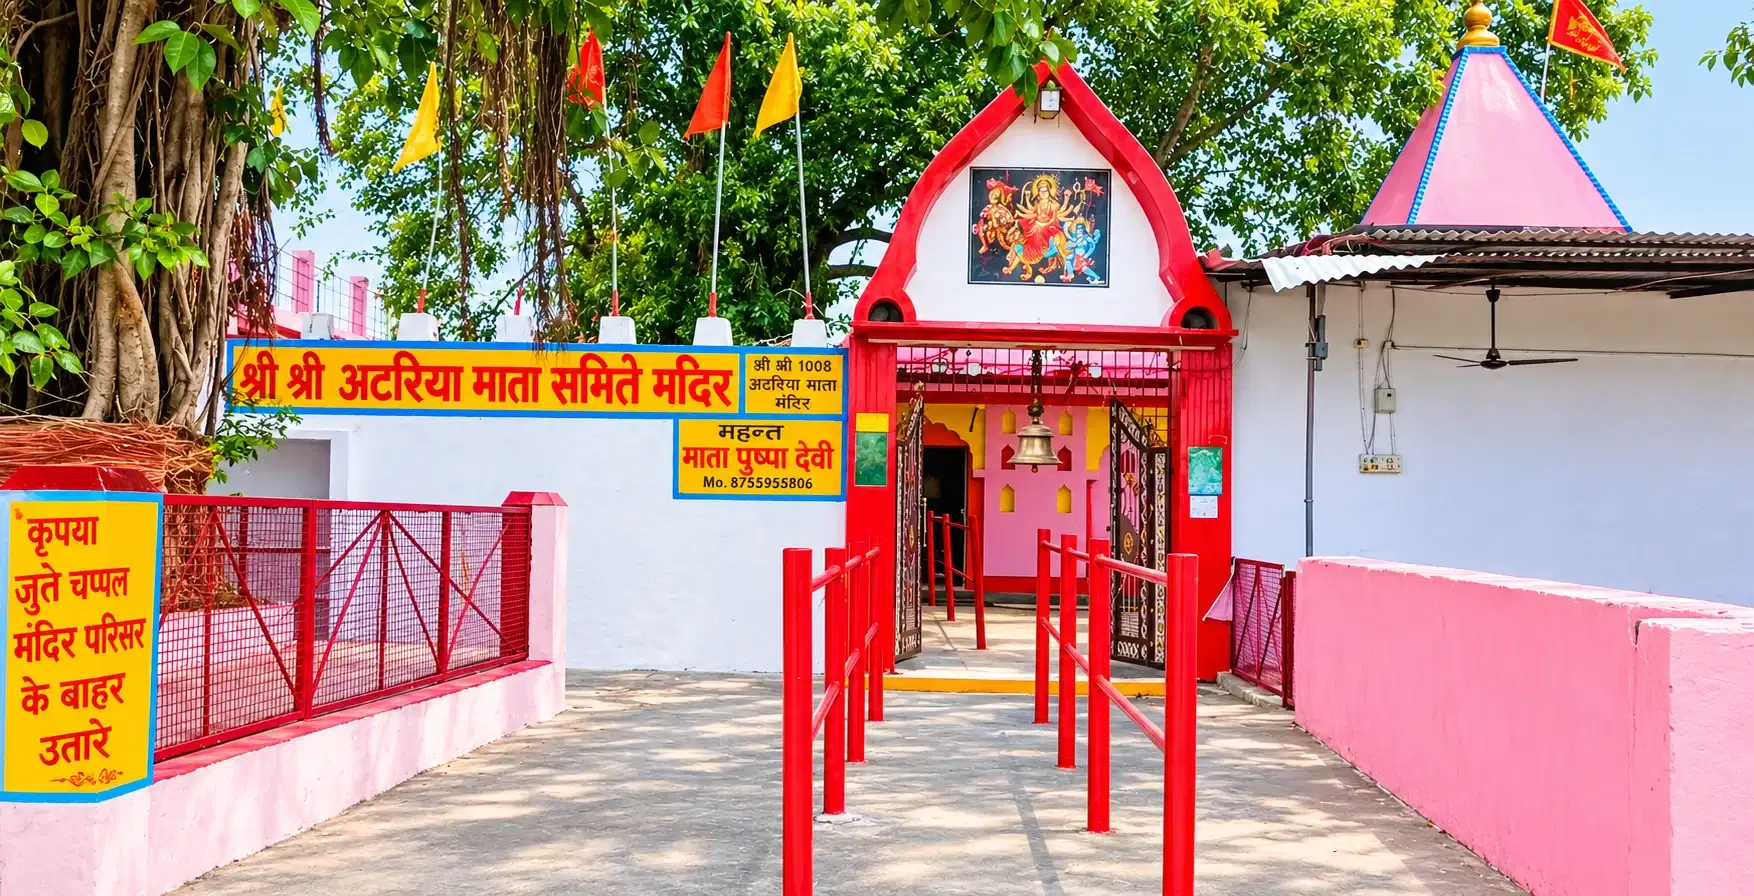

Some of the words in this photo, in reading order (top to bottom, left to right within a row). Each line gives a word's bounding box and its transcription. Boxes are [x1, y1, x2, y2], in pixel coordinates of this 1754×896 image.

[240, 350, 280, 401] श्री
[286, 350, 326, 401] श्री
[338, 350, 464, 403] अटरिया
[472, 366, 543, 404] माता
[550, 353, 643, 405] समिते
[798, 360, 832, 372] 1008
[806, 379, 838, 392] माता
[718, 424, 785, 443] महन्त
[682, 447, 730, 469] माता
[736, 447, 789, 477] पुष्पा
[795, 439, 835, 473] देवी
[703, 476, 727, 488] Mo.
[730, 477, 813, 490] 8755955806
[27, 516, 100, 558] कृपया
[15, 562, 63, 616] जुते
[69, 567, 131, 600] चप्पल
[13, 619, 78, 663] मंदिर
[84, 612, 147, 655] परिसर
[21, 675, 50, 716] के
[60, 672, 126, 710] बाहर
[39, 718, 112, 766] उतारे
